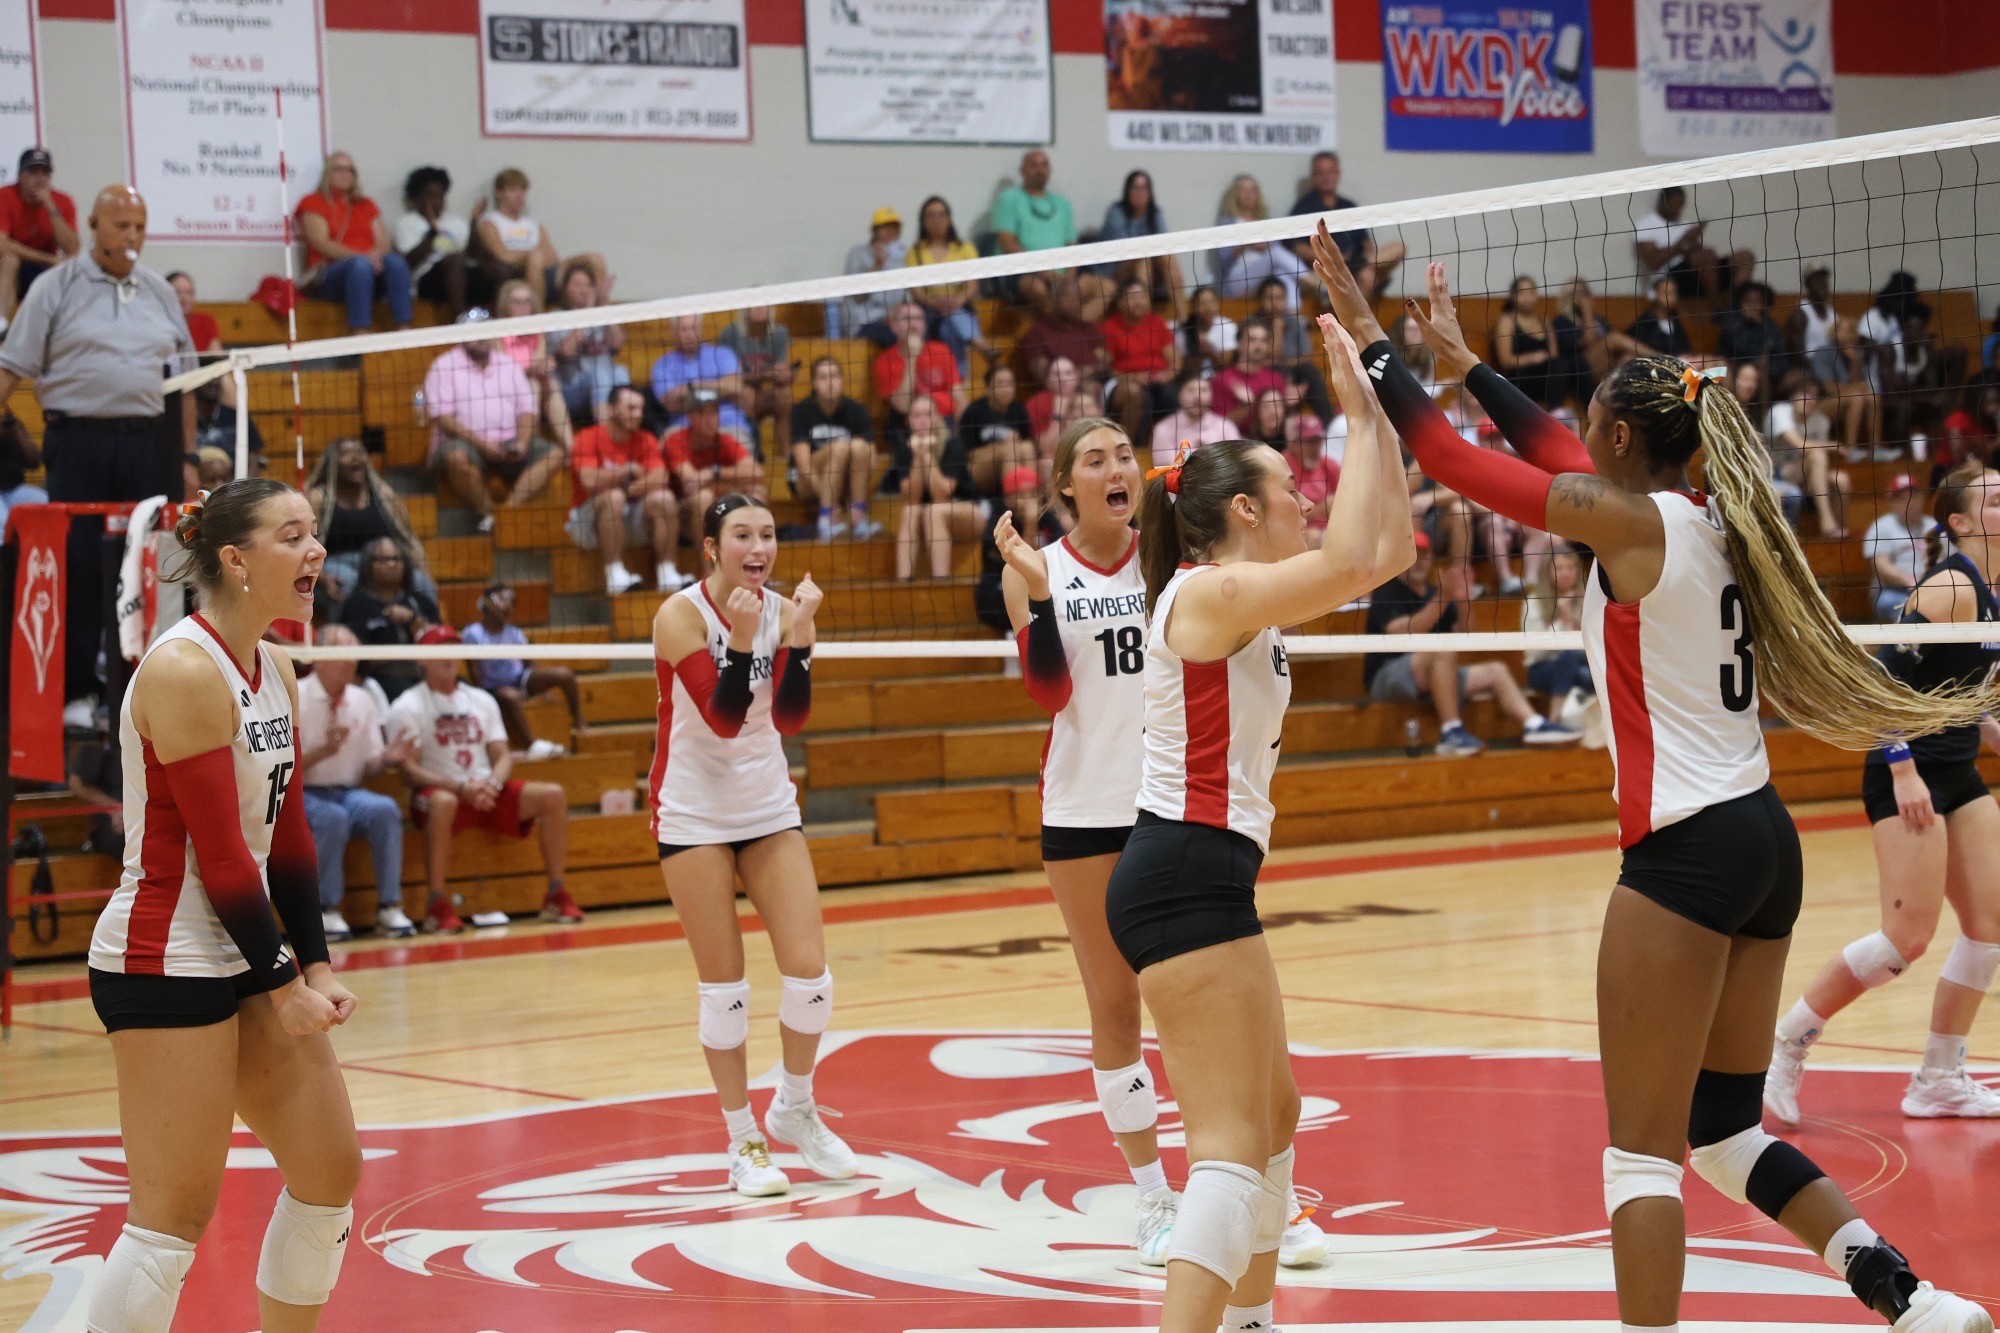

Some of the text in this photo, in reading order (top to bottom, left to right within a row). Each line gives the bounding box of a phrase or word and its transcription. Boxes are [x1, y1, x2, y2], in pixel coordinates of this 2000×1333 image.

[175, 10, 272, 33] Champions
[1661, 1, 1762, 30] FIRST
[541, 21, 733, 66] STOKES-TRAINOR
[1266, 35, 1328, 57] TRACTOR
[1663, 32, 1757, 61] TEAM
[190, 54, 246, 71] NCAA
[1385, 27, 1553, 97] WKDK
[132, 74, 199, 92] National
[1499, 69, 1584, 126] Voice
[188, 97, 267, 115] 21st Place
[1159, 121, 1214, 143] WILSON
[1244, 122, 1321, 146] NEWBERRY
[199, 142, 261, 159] Ranked
[212, 161, 296, 182] Nationay
[175, 217, 284, 231] Season Recor
[1066, 592, 1146, 622] NEWBERR
[1095, 626, 1144, 677] 18
[1720, 584, 1754, 712] 3
[244, 714, 294, 753] NEWBER
[265, 761, 294, 825] 15
